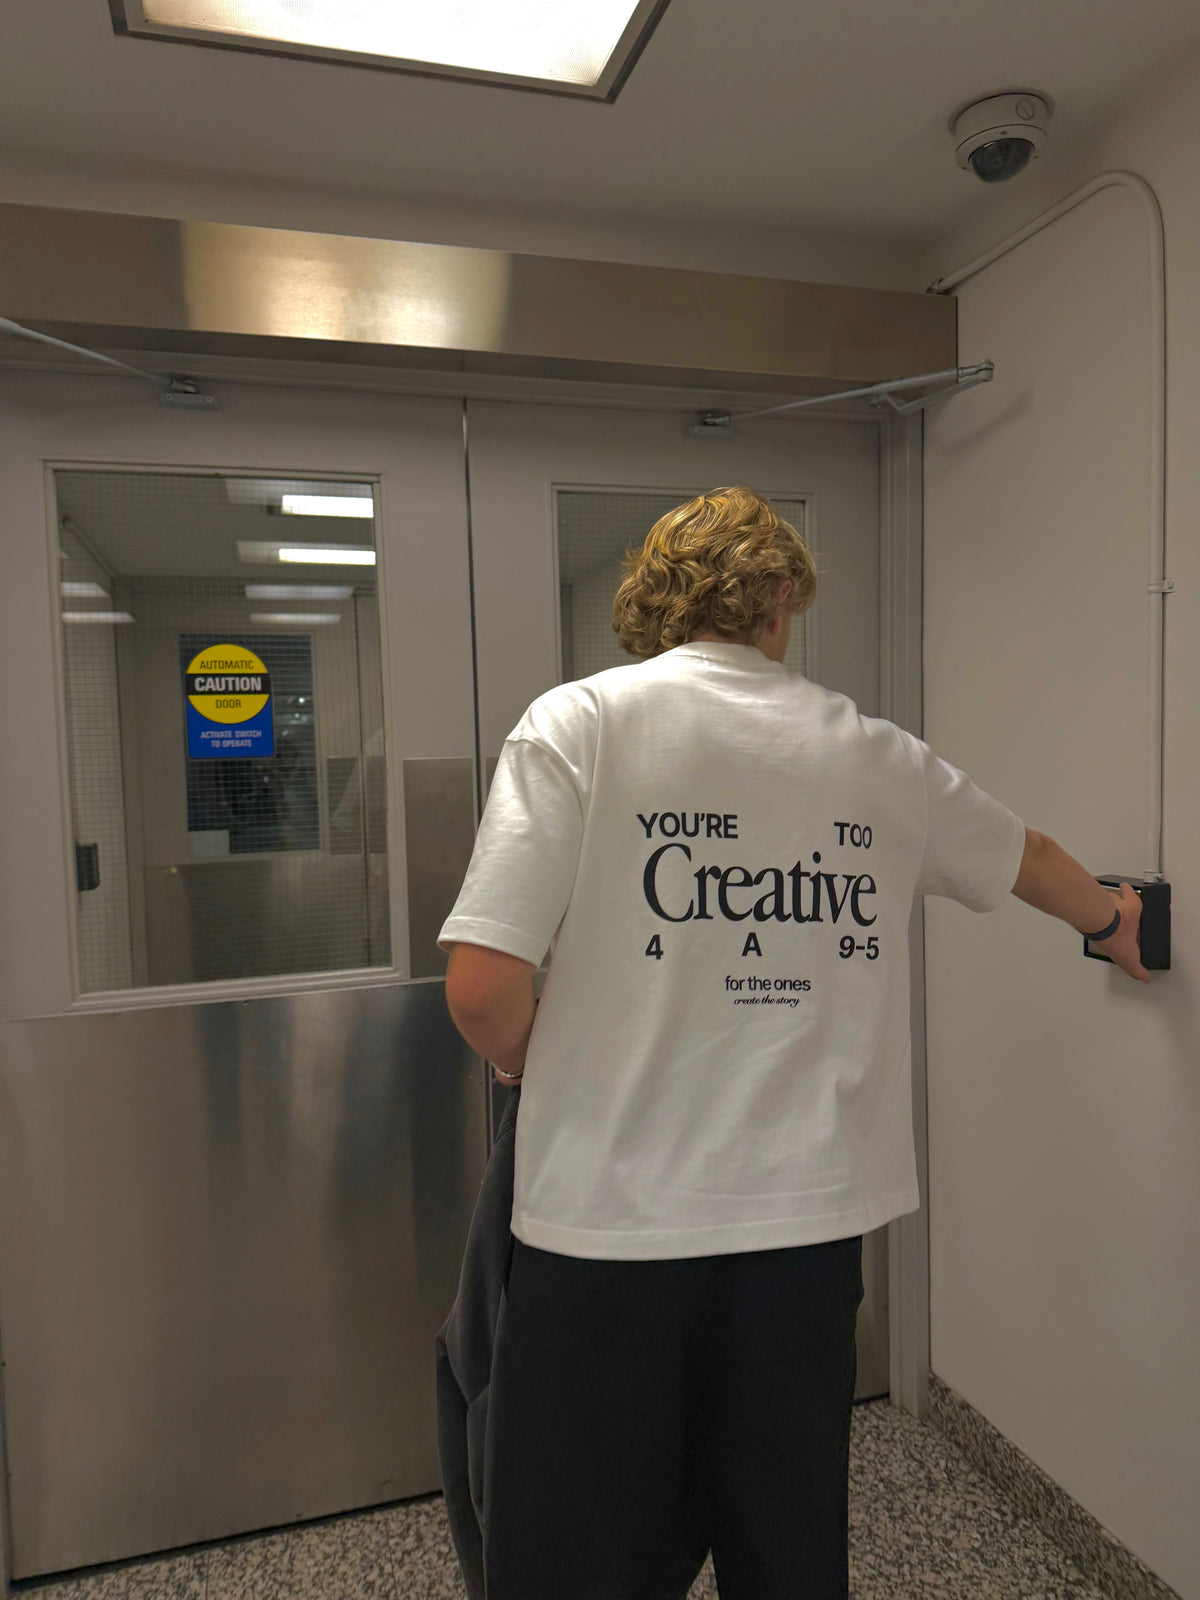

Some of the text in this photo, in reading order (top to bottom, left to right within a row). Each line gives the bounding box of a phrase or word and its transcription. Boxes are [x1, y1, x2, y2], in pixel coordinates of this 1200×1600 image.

[199, 660, 254, 670] AUTOMATIC
[194, 677, 262, 692] CAUTION
[215, 699, 242, 709] DOOR
[200, 730, 262, 739] ACTIVATE SWITCH
[222, 740, 252, 748] OPERATE
[637, 812, 873, 849] YOU'RE TOO
[643, 843, 878, 927] Creative
[645, 932, 880, 960] 4 A 9-5
[725, 975, 811, 991] for the ones
[733, 995, 801, 1008] create the story
